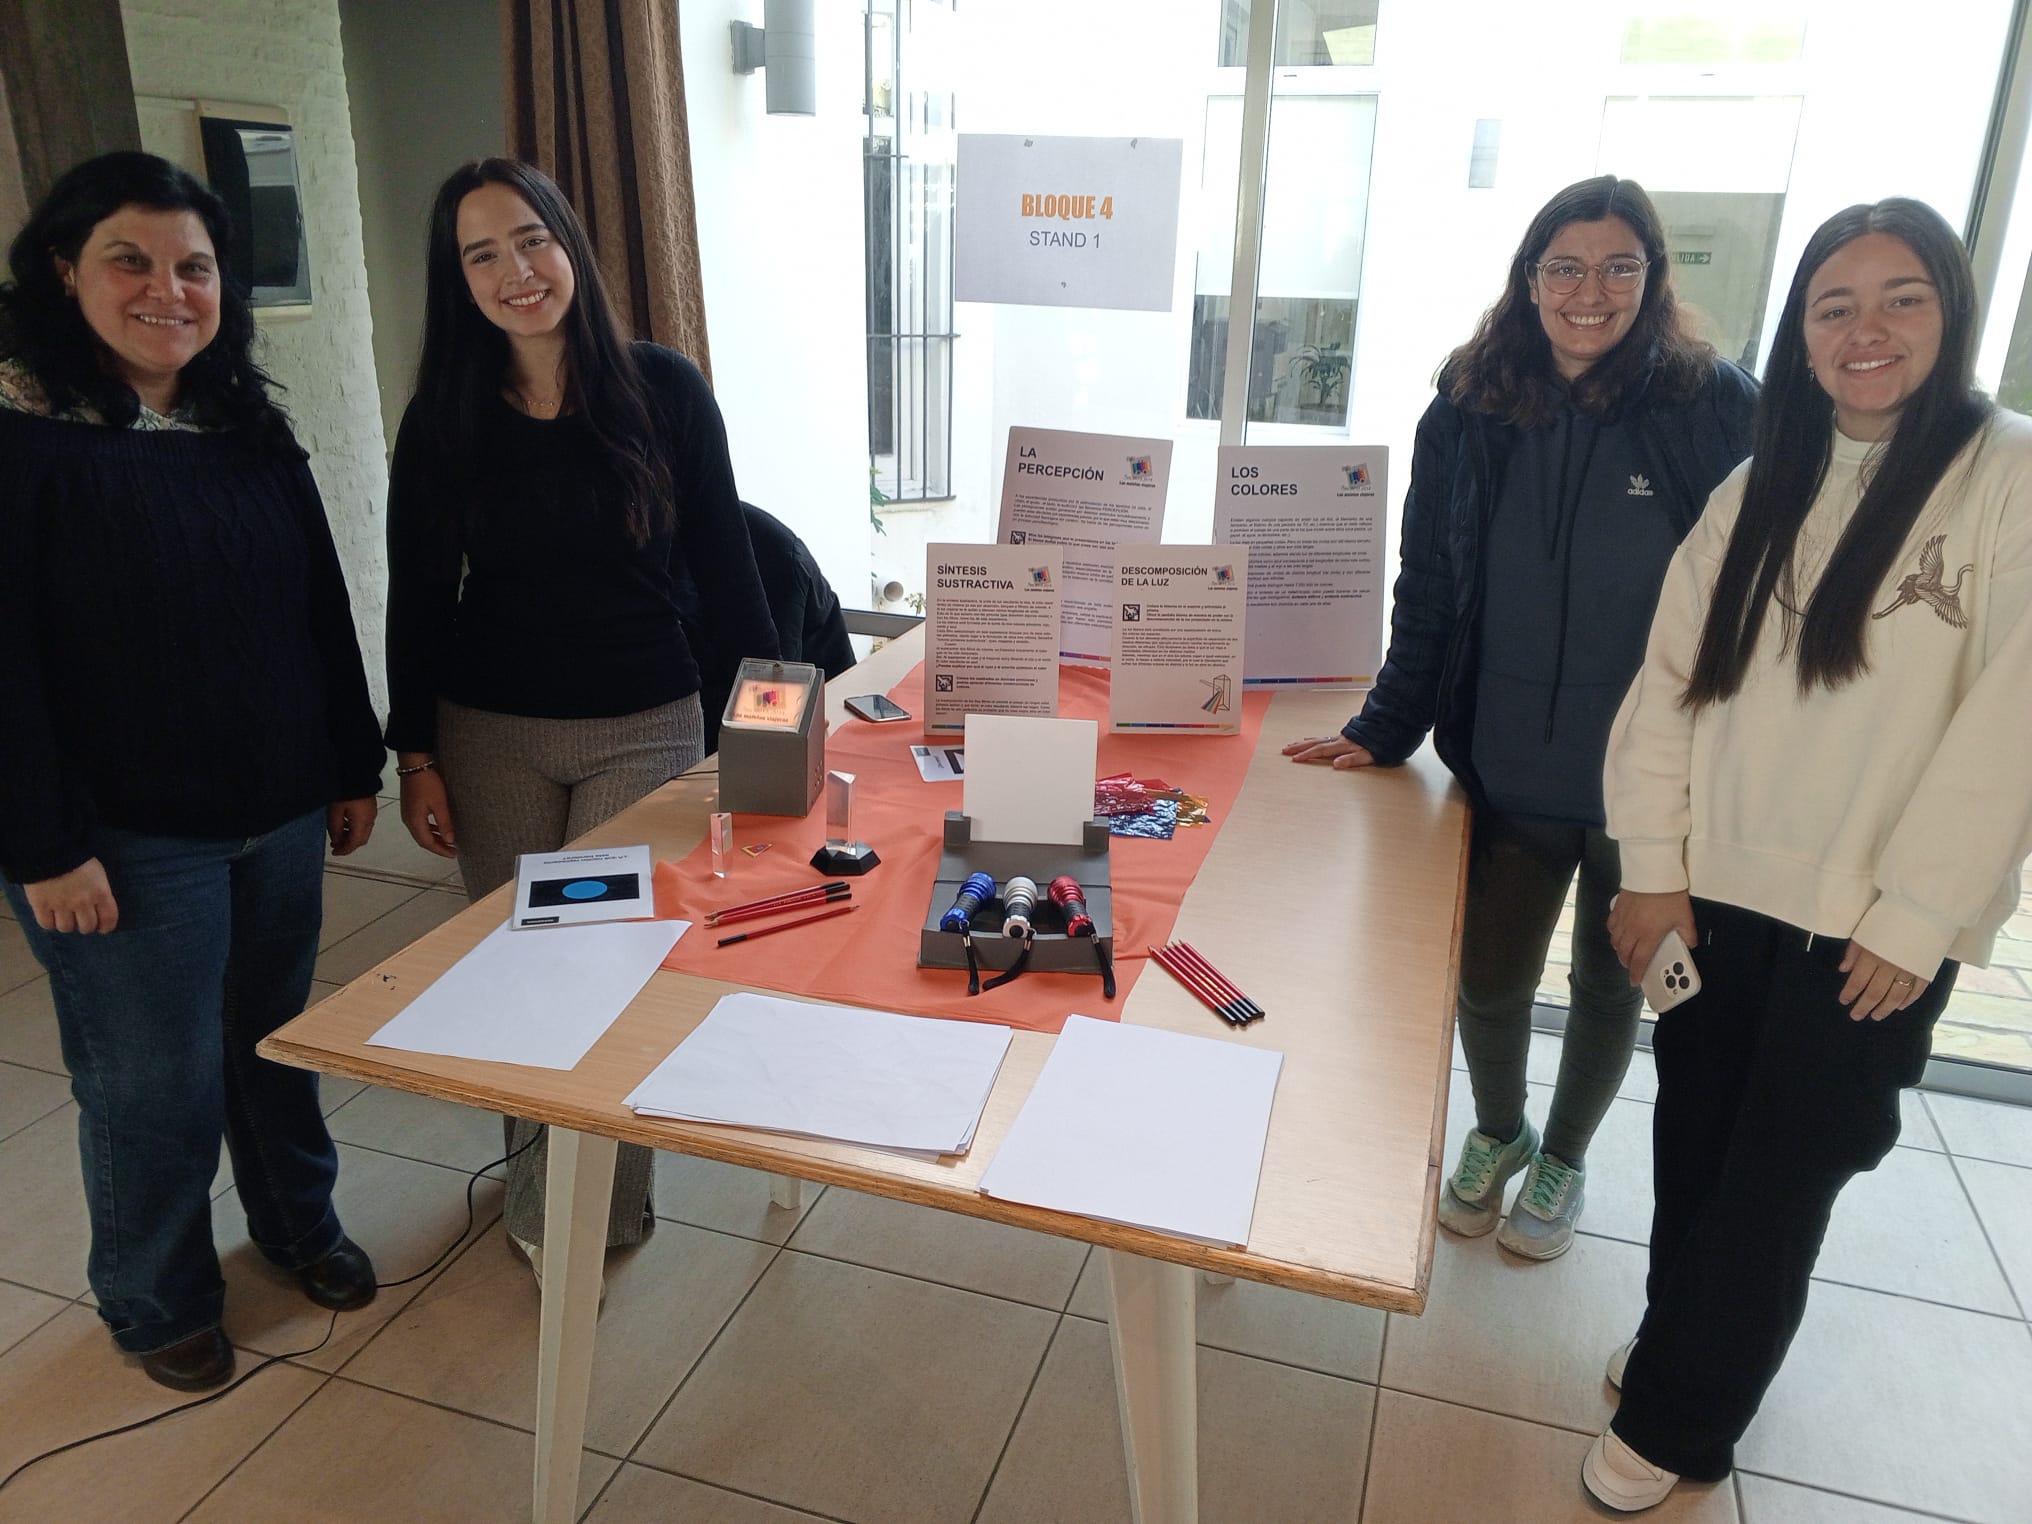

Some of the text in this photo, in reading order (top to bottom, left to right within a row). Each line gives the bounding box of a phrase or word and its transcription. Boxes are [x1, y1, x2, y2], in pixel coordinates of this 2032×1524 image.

[1021, 193, 1113, 220] BLOQUE 4
[1029, 230, 1100, 249] STAND 1
[1019, 446, 1037, 459] LA
[1018, 462, 1105, 482] PERCEPCIÓN
[1231, 466, 1259, 479] LOS
[1231, 483, 1298, 496] COLORES
[1627, 487, 1654, 497] adidas
[937, 563, 987, 576] SÍNTESIS
[1121, 565, 1208, 576] DESCOMPOSICIÓN
[936, 578, 1014, 590] SUSTRACTIVA
[1121, 577, 1170, 587] DE LA LUZ
